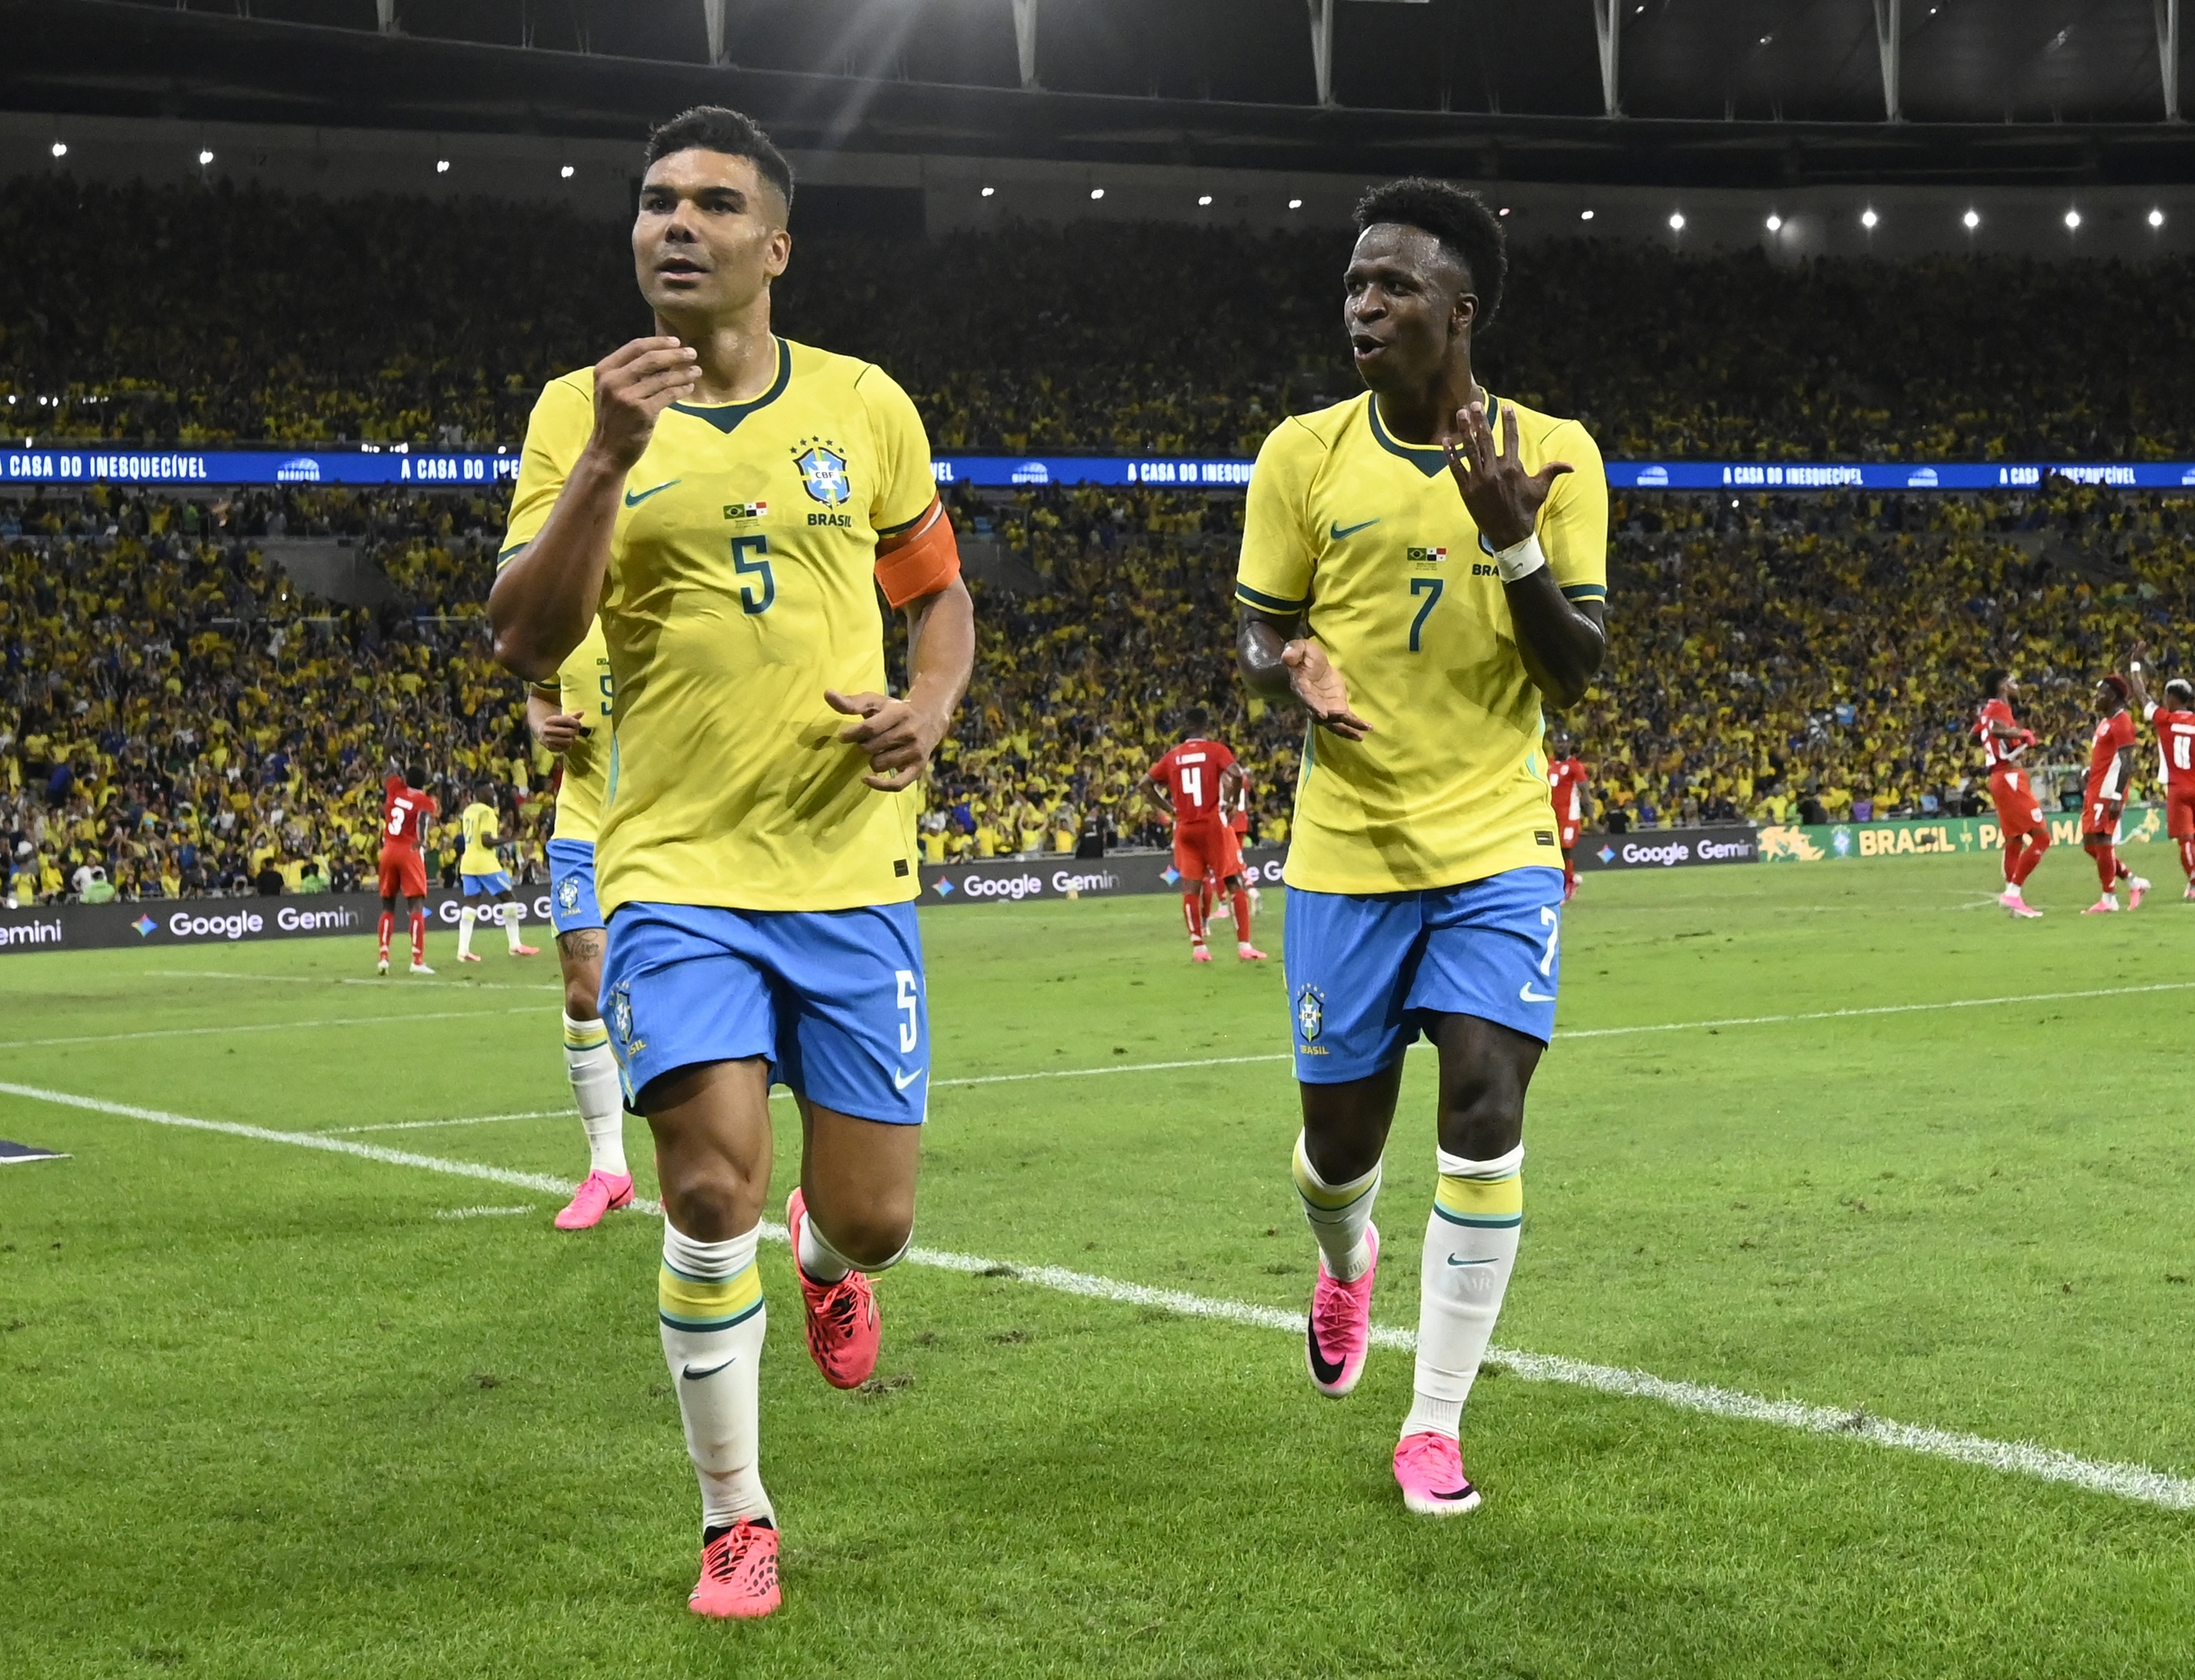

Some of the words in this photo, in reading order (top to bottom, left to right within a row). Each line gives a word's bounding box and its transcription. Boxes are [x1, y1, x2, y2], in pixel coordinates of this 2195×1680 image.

[9, 455, 53, 477] CASA
[60, 456, 82, 477] DO
[90, 454, 207, 480] INESQUECÍVEL
[401, 459, 411, 479] A
[417, 459, 457, 479] CASA
[464, 459, 483, 479] DO
[1128, 463, 1137, 481] A
[1140, 463, 1175, 481] CASA
[1179, 463, 1197, 482] DO
[1734, 467, 1764, 484] CASA
[807, 513, 852, 527] BRASIL
[730, 534, 775, 614] 5
[1409, 577, 1444, 653] 7
[1181, 767, 1203, 807] 4
[388, 807, 404, 836] 3
[2093, 803, 2103, 821] 7
[1623, 842, 1689, 866] Google
[1858, 827, 1956, 856] BRASIL
[964, 873, 1042, 899] Google
[169, 910, 263, 939] Google
[1540, 906, 1559, 977] 7
[895, 970, 919, 1053] 5
